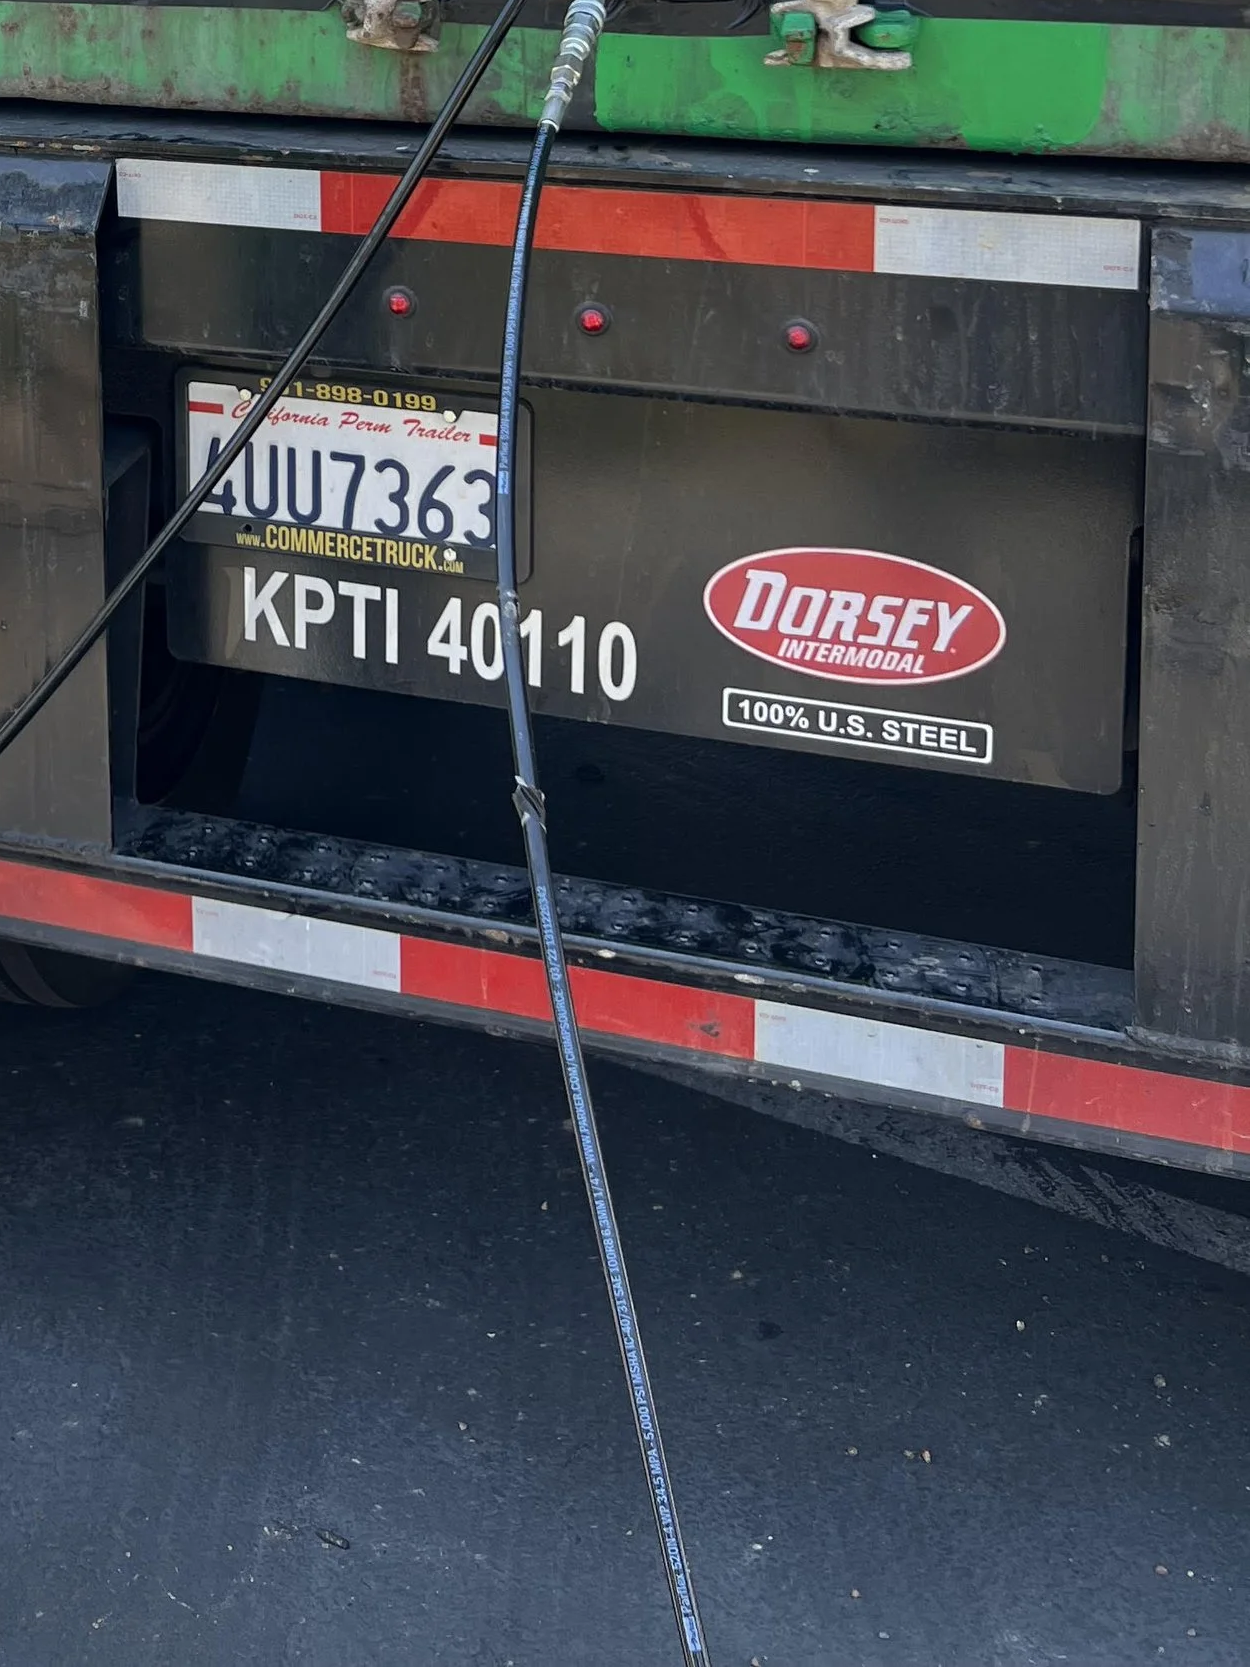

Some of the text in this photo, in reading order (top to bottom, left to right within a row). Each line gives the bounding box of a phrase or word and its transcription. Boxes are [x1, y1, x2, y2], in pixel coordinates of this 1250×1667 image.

[506, 319, 516, 332] PSI
[259, 376, 438, 412] 1-898-0199
[231, 402, 472, 443] Cifornia Perm Trailer
[202, 437, 498, 548] 4UU7363
[733, 569, 974, 653] DORSEY
[242, 566, 639, 703] KPTI 40110
[778, 638, 925, 675] INTERMODAL
[738, 699, 977, 753] 100% U.S. STEEL
[594, 1198, 611, 1237] 6.3MM
[602, 1237, 619, 1273] 100R8
[611, 1274, 624, 1297] SAE
[625, 1350, 642, 1384] MSHA
[633, 1384, 646, 1405] PSI
[637, 1405, 655, 1440] 5,000
[646, 1447, 662, 1475] MPA
[652, 1475, 668, 1504] 34.5
[658, 1504, 672, 1524] WP
[662, 1525, 683, 1570] 520N-4
[673, 1573, 693, 1614] Parflex
